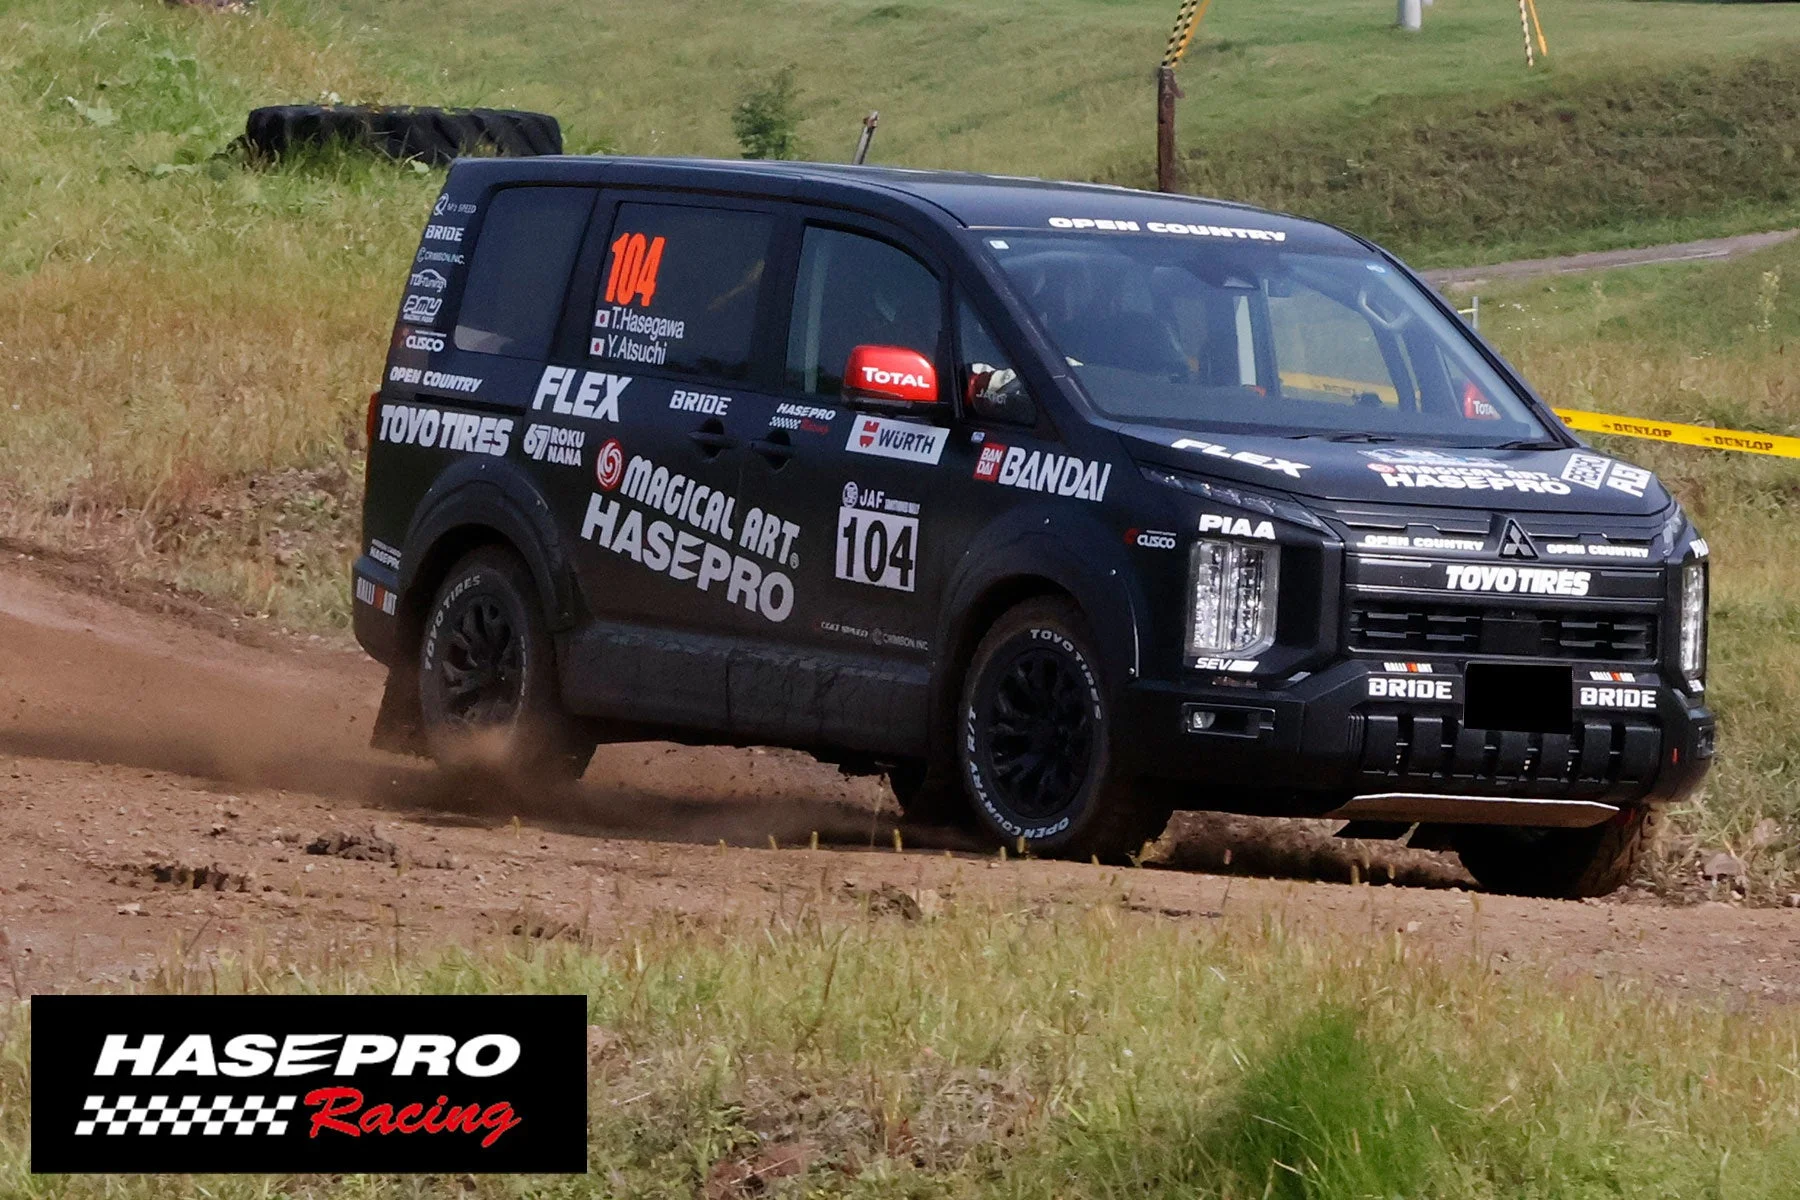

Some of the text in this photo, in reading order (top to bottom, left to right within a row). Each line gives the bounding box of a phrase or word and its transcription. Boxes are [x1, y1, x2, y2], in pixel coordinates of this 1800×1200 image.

[425, 225, 464, 242] BRIDE
[1049, 217, 1286, 242] OPEN COUNTRY
[605, 232, 667, 307] 104
[611, 306, 685, 341] T.Hasegawa
[405, 335, 445, 352] CUSCO
[608, 333, 668, 365] Y.Atsuchi
[389, 366, 483, 393] OPEN COUNTRY
[862, 366, 930, 388] TOTAL
[532, 365, 632, 423] FLEX
[669, 390, 732, 416] BRIDE
[776, 402, 836, 421] HASEPRO
[550, 426, 586, 449] ROKU
[1613, 423, 1672, 438] DUNLOP
[981, 447, 1003, 463] BAN
[1714, 436, 1774, 451] DUNLOP
[547, 445, 582, 467] NANA
[976, 460, 994, 475] DAI
[1171, 438, 1311, 478] FLEX
[998, 446, 1112, 502] BANDAI
[1380, 473, 1572, 495] HASEPRO
[619, 454, 736, 541] MAGICAL
[860, 489, 885, 509] JAF
[1198, 513, 1276, 540] PIAA
[843, 516, 913, 588] 104
[1137, 534, 1176, 549] CUSCO
[1364, 534, 1485, 551] OPEN COUNTRY
[1546, 543, 1649, 558] OPEN COUNTRY
[580, 492, 795, 623] HASEPRO
[442, 573, 482, 609] TIRES
[1029, 628, 1075, 652] TOYO
[1194, 657, 1233, 671] SEV
[1368, 677, 1453, 700] BRIDE
[1580, 687, 1657, 709] BRIDE
